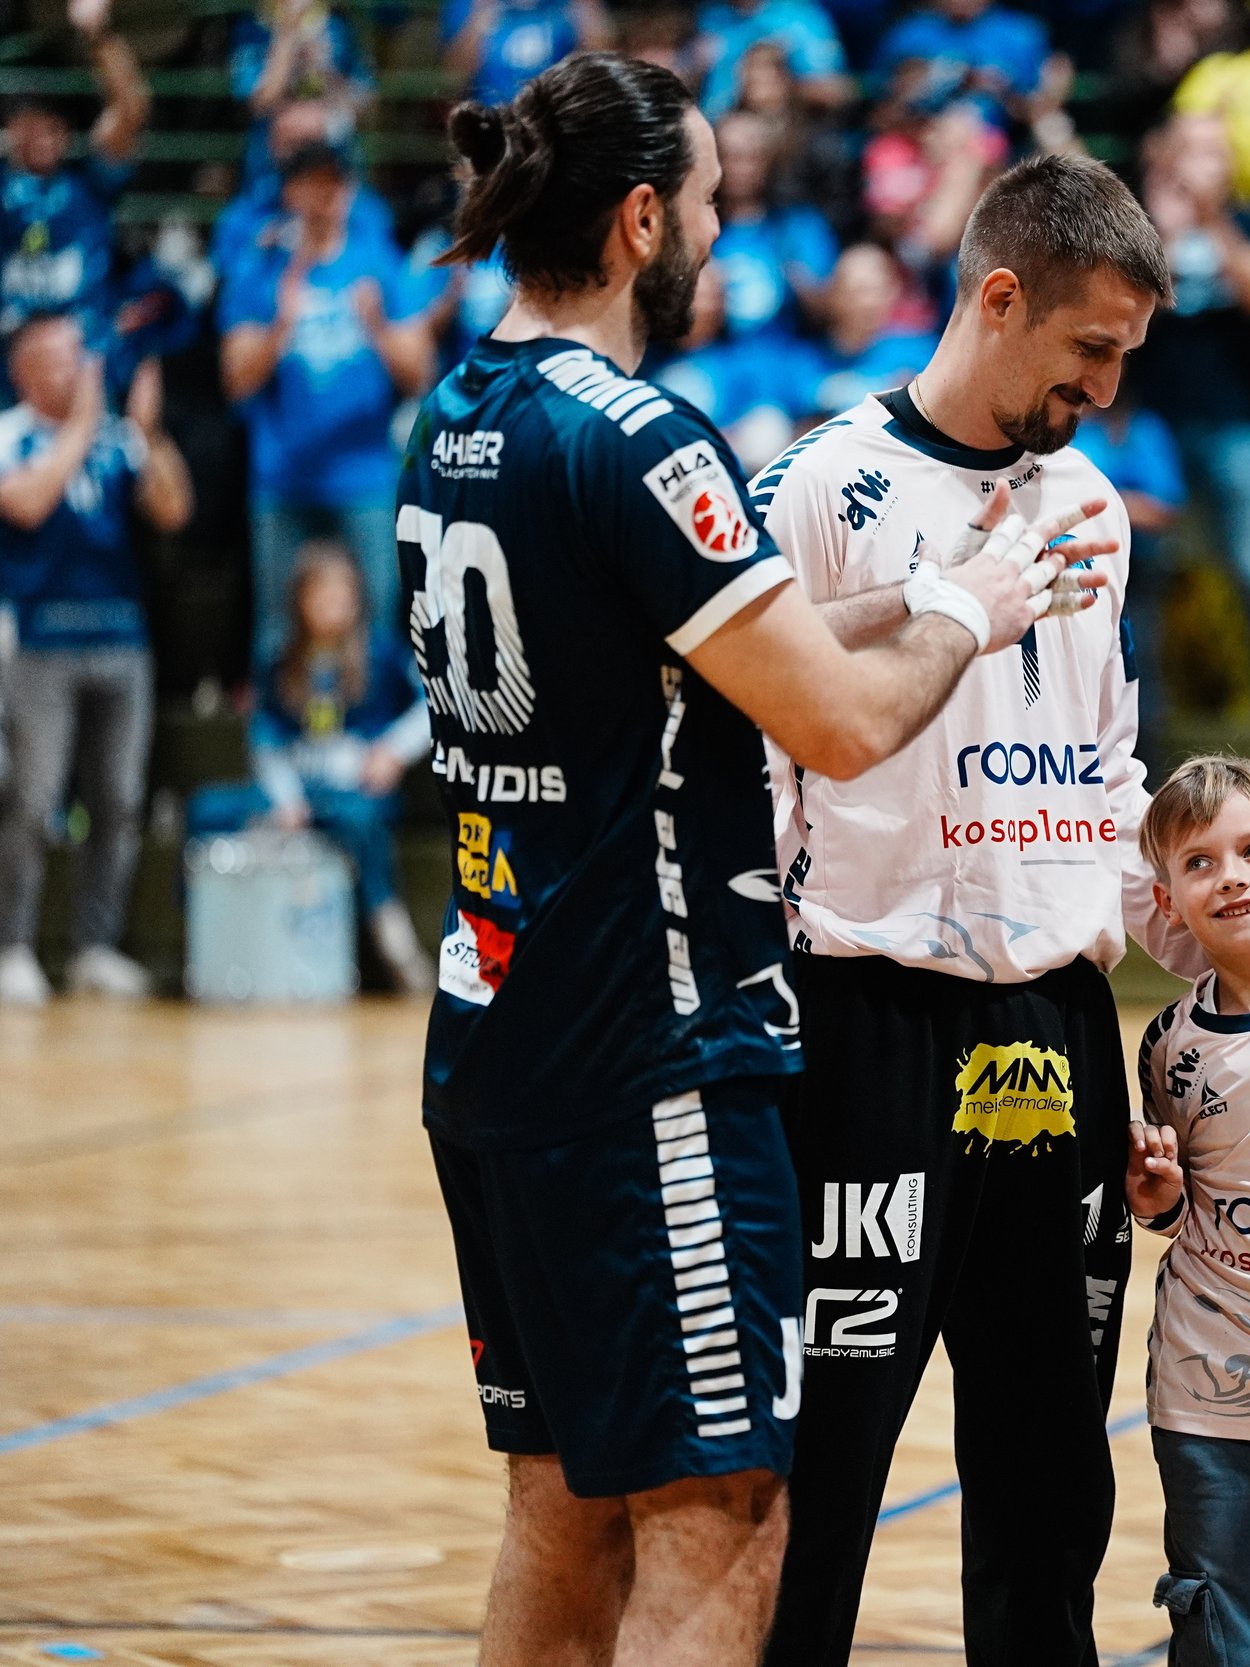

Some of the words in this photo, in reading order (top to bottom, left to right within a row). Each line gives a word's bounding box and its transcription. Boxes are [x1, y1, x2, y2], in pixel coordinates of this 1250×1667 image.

[659, 452, 712, 492] HLA
[940, 809, 1118, 852] kosaplane
[965, 1057, 1068, 1096] MM
[1200, 1101, 1228, 1120] ELECT
[811, 1182, 891, 1259] JK
[906, 1177, 919, 1258] CONSULTING
[772, 1316, 802, 1421] J
[802, 1346, 896, 1358] READY2MUSIC
